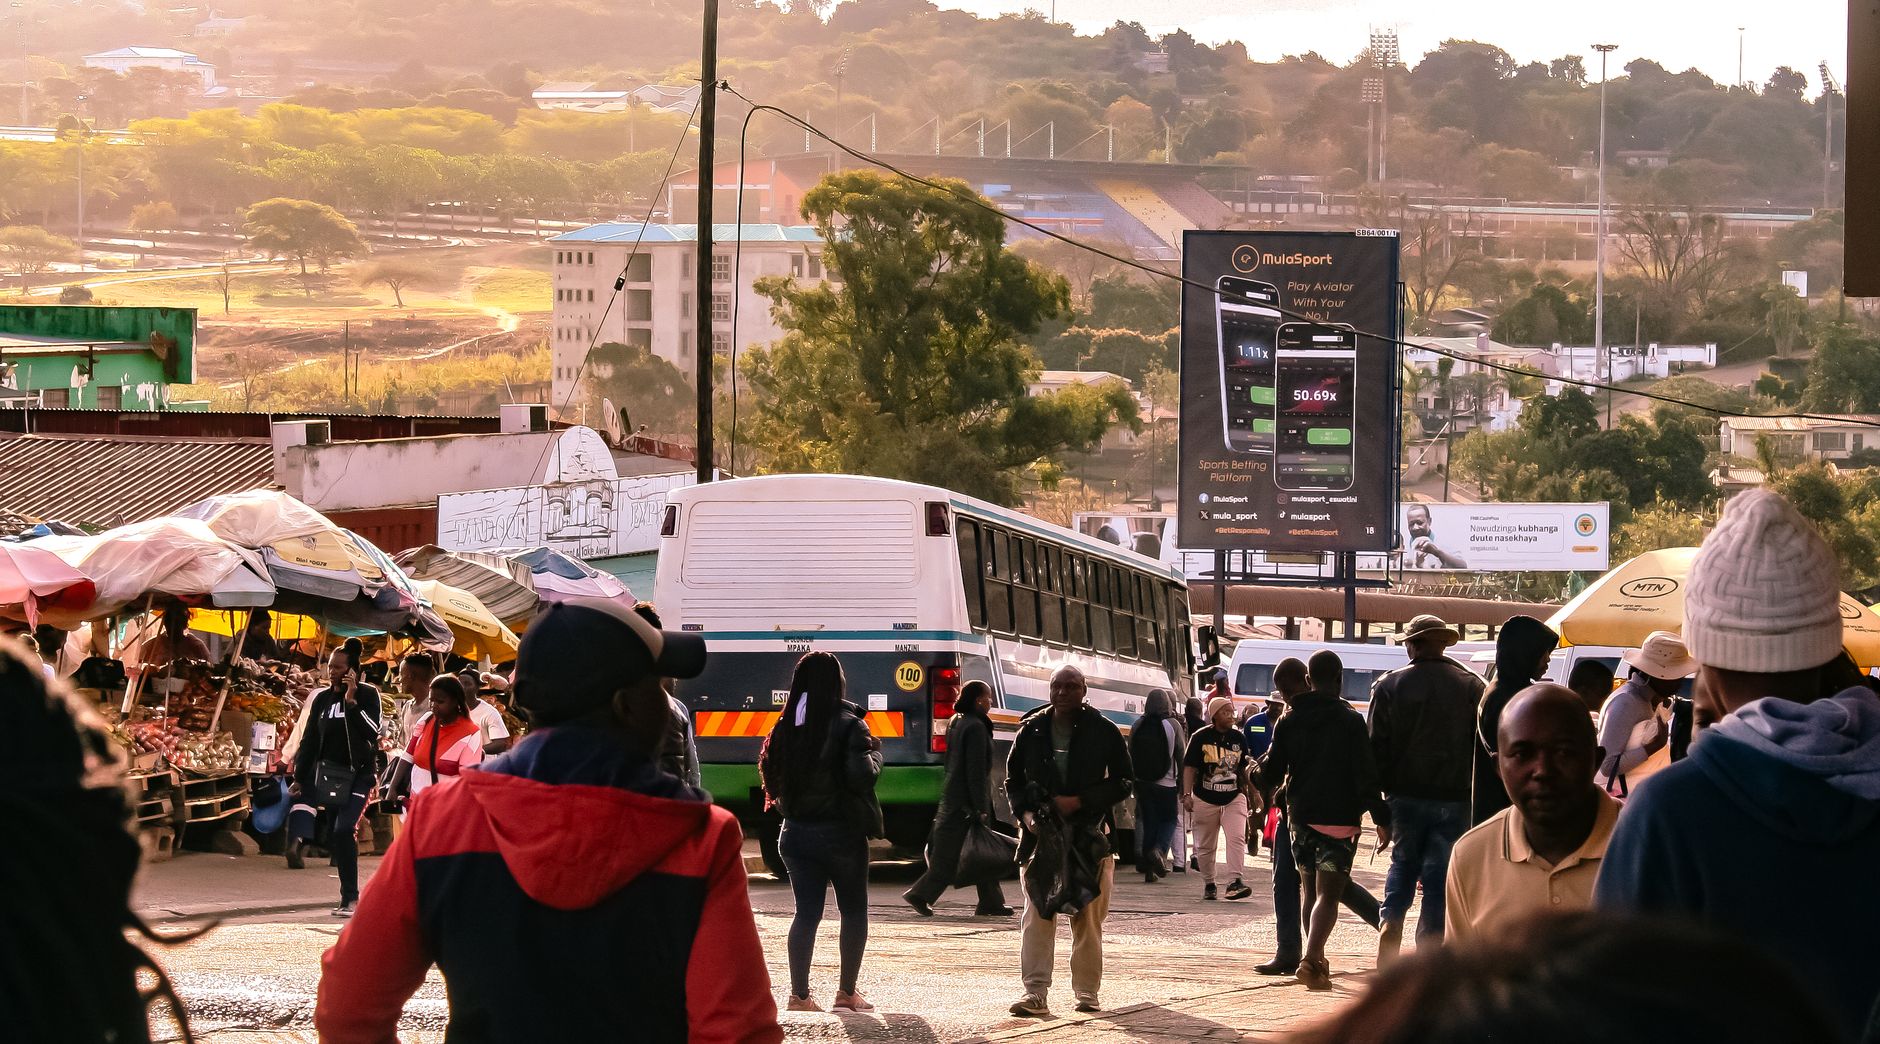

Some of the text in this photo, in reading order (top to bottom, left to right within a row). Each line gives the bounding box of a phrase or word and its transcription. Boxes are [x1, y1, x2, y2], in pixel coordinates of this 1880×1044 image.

[1262, 253, 1332, 267] MulaSport
[1287, 281, 1355, 292] Play Aviator
[1293, 298, 1346, 308] With Your
[1238, 345, 1269, 360] 1.11x
[1293, 389, 1338, 402] 50.69x
[1199, 460, 1267, 472] Sports Betting
[1210, 473, 1253, 483] Platform
[1213, 496, 1249, 504] MulaSport
[1291, 496, 1358, 504] mulasport_eswatini
[1213, 512, 1258, 521] mula_sport
[1290, 512, 1331, 522] mulasport
[1215, 527, 1271, 536] #BetResponsibly
[1289, 529, 1339, 537] #BetMulaSport
[1365, 526, 1375, 535] 18
[1470, 525, 1558, 534] Nawudzinga kubhanga
[1470, 534, 1538, 543] dvute nasekhaya
[1633, 584, 1666, 592] MTN
[787, 644, 811, 652] MPAKA
[900, 667, 921, 683] 100
